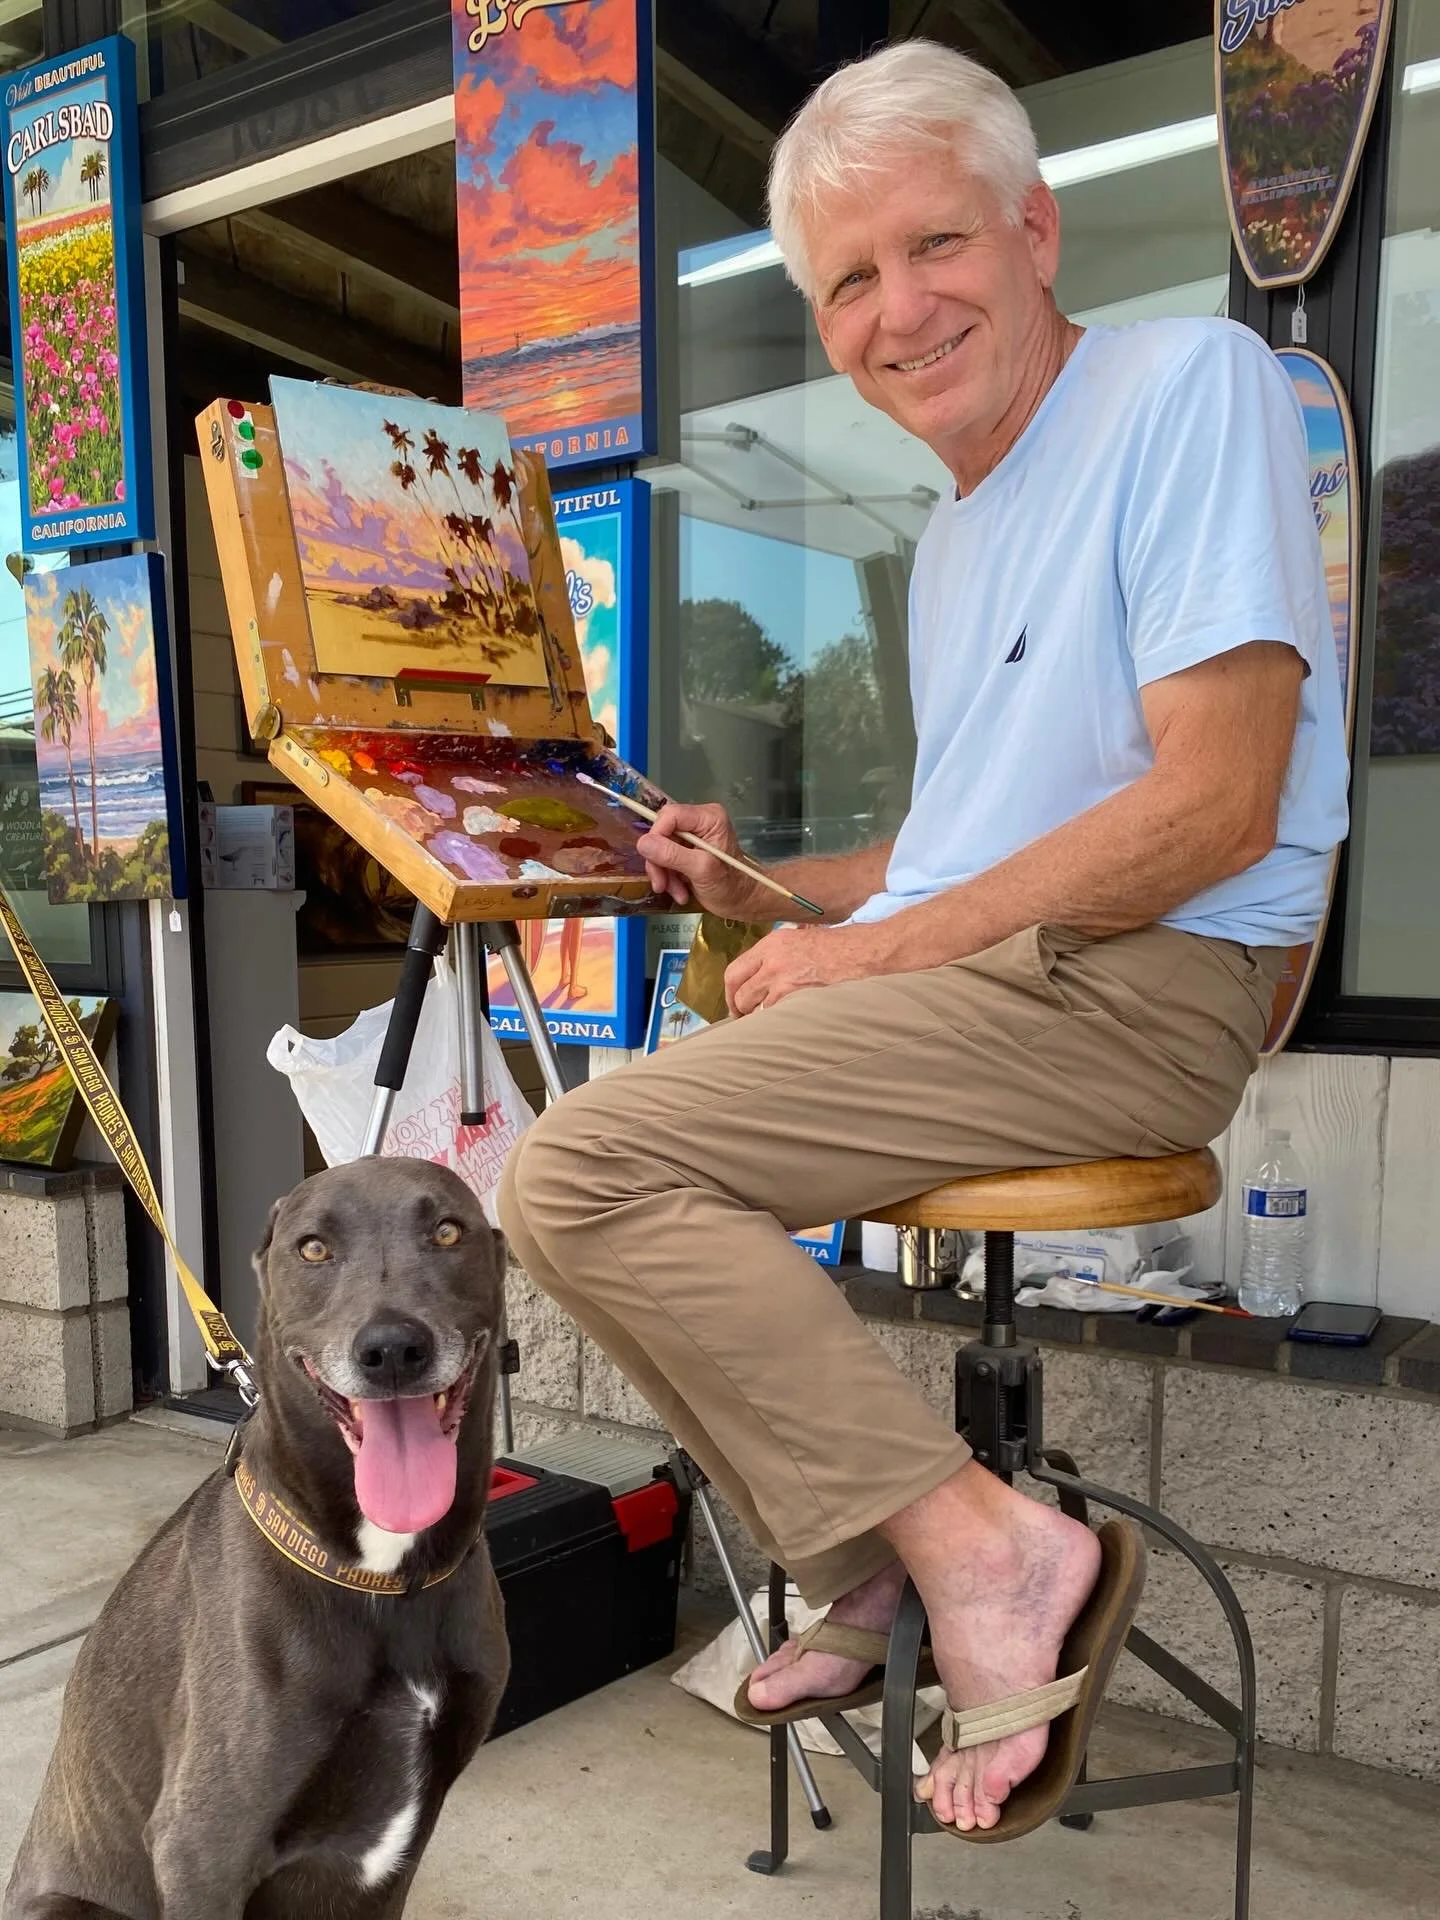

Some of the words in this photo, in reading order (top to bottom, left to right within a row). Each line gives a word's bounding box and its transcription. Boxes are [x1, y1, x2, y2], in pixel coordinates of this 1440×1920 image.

[34, 52, 106, 92] BEAUTIFUL
[7, 101, 114, 174] CARLSBAD
[523, 427, 629, 458] FORNIA
[31, 512, 127, 541] CALIFORNIA
[32, 969, 54, 998] DIEGO
[44, 998, 75, 1034] PADRES
[489, 1016, 616, 1040] CALORNIA
[70, 1047, 91, 1067] SAN
[78, 1063, 102, 1093] DIEGO
[91, 1090, 122, 1135] PADRES
[121, 1145, 138, 1170] SAN
[132, 1167, 149, 1199] DIEGO
[265, 1508, 289, 1539] SAN
[287, 1529, 328, 1568] DIEGO
[335, 1564, 402, 1589] PADRES
